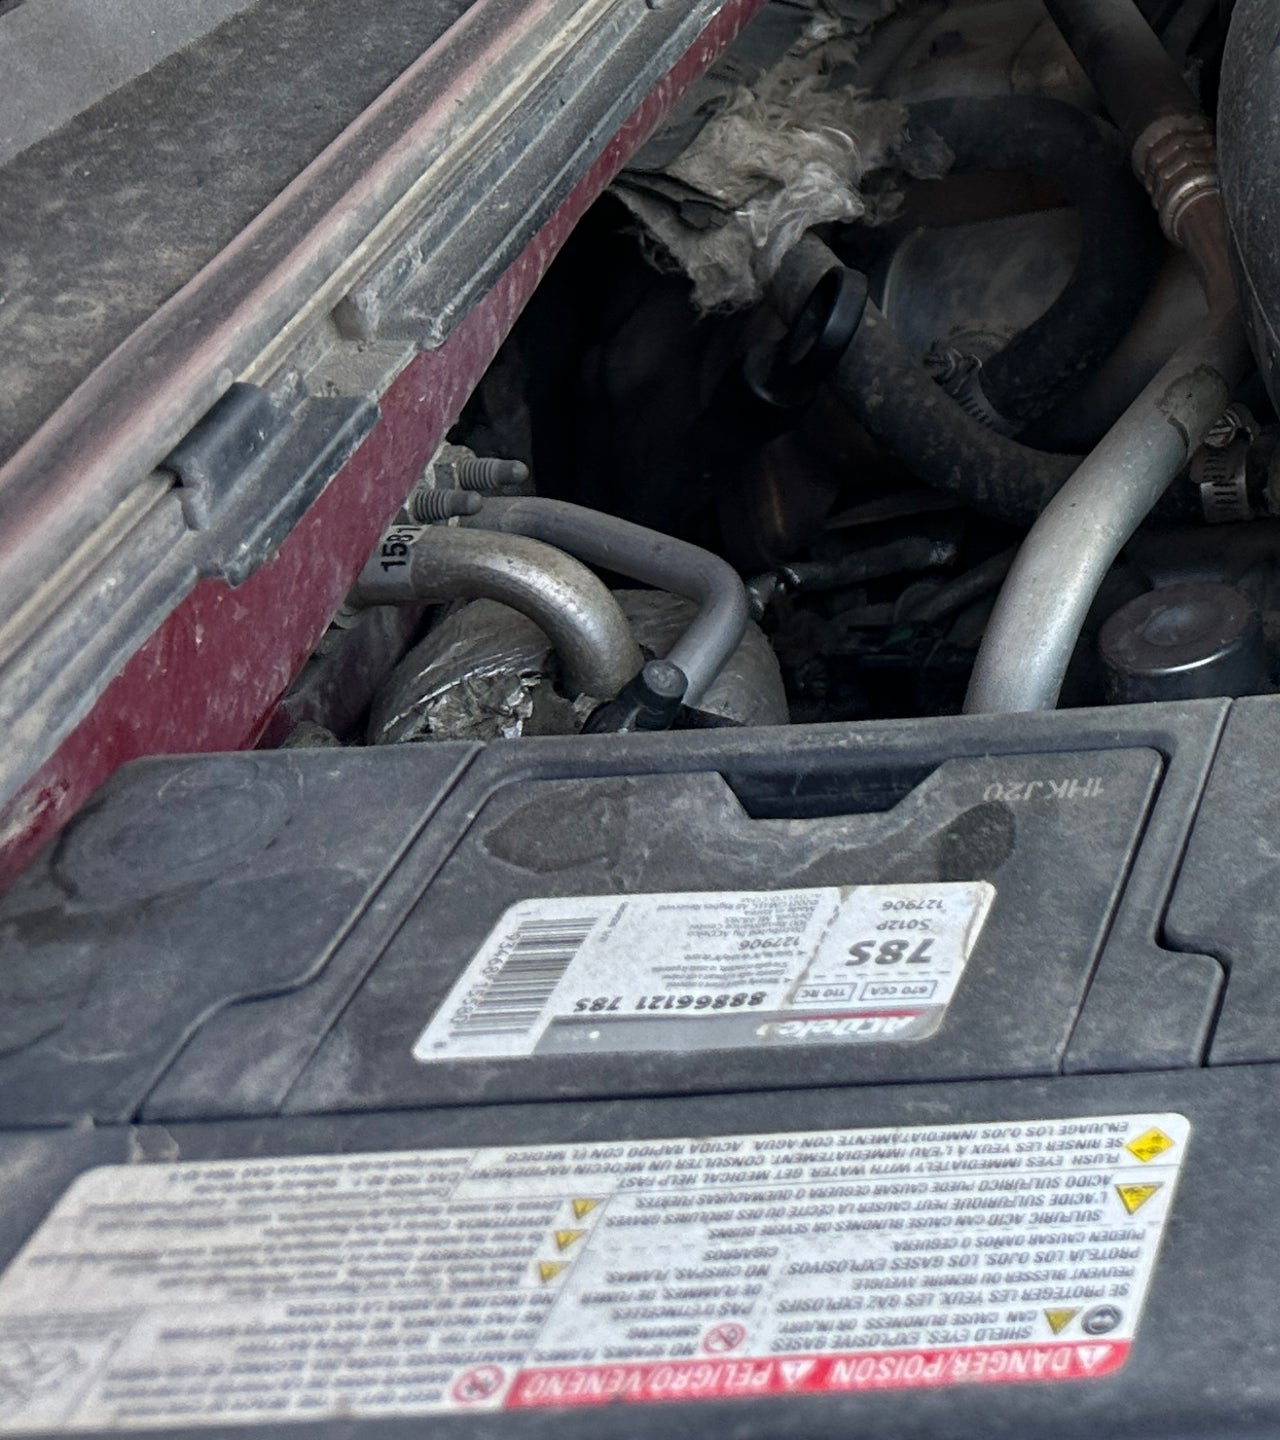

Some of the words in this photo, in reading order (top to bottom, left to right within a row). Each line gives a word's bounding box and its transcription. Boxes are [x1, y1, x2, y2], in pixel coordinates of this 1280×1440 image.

[880, 898, 944, 913] 127906
[738, 938, 802, 951] 127906
[844, 938, 938, 966] 78S
[573, 995, 620, 1013] 78S
[634, 991, 768, 1011] 88866121
[978, 1126, 1023, 1141] OJOS
[1022, 1124, 1056, 1138] LOS
[1054, 1121, 1130, 1137] ENJUAGE
[686, 1139, 744, 1155] ACUDA
[794, 1135, 835, 1150] CON
[968, 1141, 1012, 1156] YEUX
[1012, 1139, 1044, 1154] LES
[1043, 1136, 1103, 1152] RINSER
[1103, 1135, 1126, 1149] SE
[646, 1157, 674, 1172] UN
[672, 1153, 768, 1171] CONSULTER
[913, 1156, 1024, 1173] IMMEDIATELY
[1022, 1154, 1066, 1168] EYES
[1070, 1151, 1121, 1165] FLUSH
[697, 1168, 772, 1184] MEDICAL
[771, 1167, 805, 1180] GET
[867, 1161, 913, 1175] WITH
[654, 1172, 699, 1186] HELP
[945, 1253, 980, 1269] LOS
[1031, 1248, 1066, 1264] LOS
[1066, 1244, 1142, 1262] PROTEJA
[886, 1254, 946, 1272] GASES
[971, 1324, 1034, 1342] SHIELD
[825, 1344, 1075, 1385] DANGER/POISON
[513, 1360, 778, 1402] PELIGRO/VENENO
